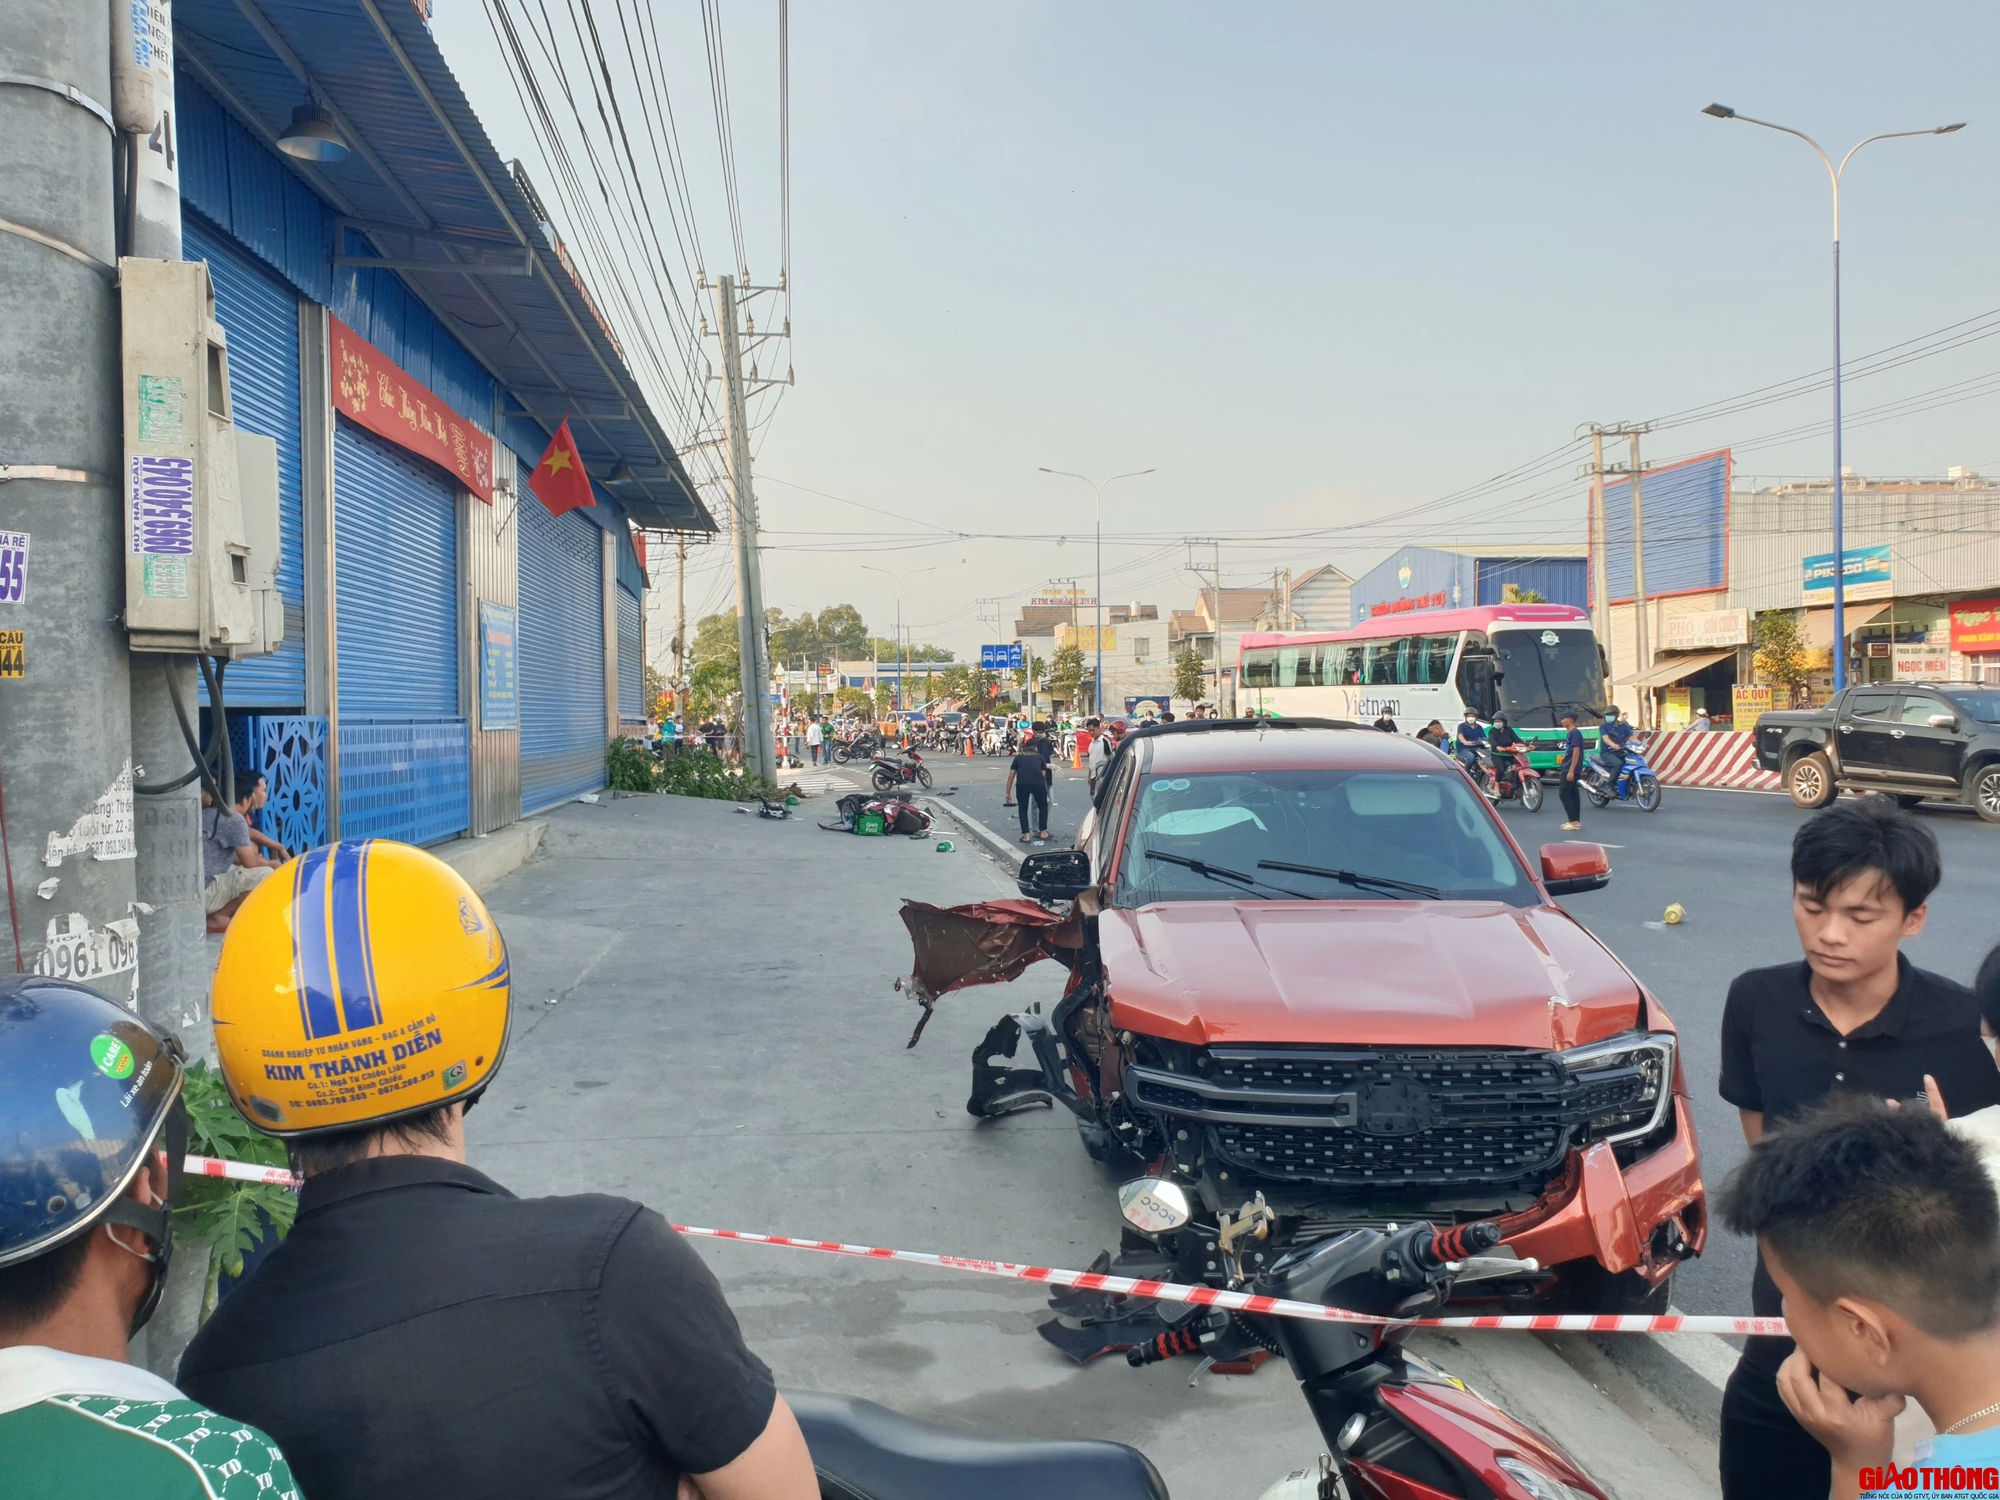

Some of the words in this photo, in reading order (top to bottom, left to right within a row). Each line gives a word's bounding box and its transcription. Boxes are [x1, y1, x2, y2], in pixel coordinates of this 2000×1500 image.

[149, 110, 174, 171] 4
[131, 456, 140, 485] CẦU
[131, 488, 140, 521] HẦM
[143, 457, 193, 554] 0969.540.045
[132, 524, 140, 552] HÚT
[1066, 628, 1114, 638] PHOO
[1342, 689, 1401, 719] Vietnam
[115, 820, 124, 833] 22
[264, 1064, 306, 1081] KIM
[309, 1055, 387, 1079] THÀNH
[393, 1028, 443, 1062] DIỄN
[129, 1083, 140, 1096] xe
[136, 1075, 145, 1087] an
[141, 1060, 153, 1077] toàn
